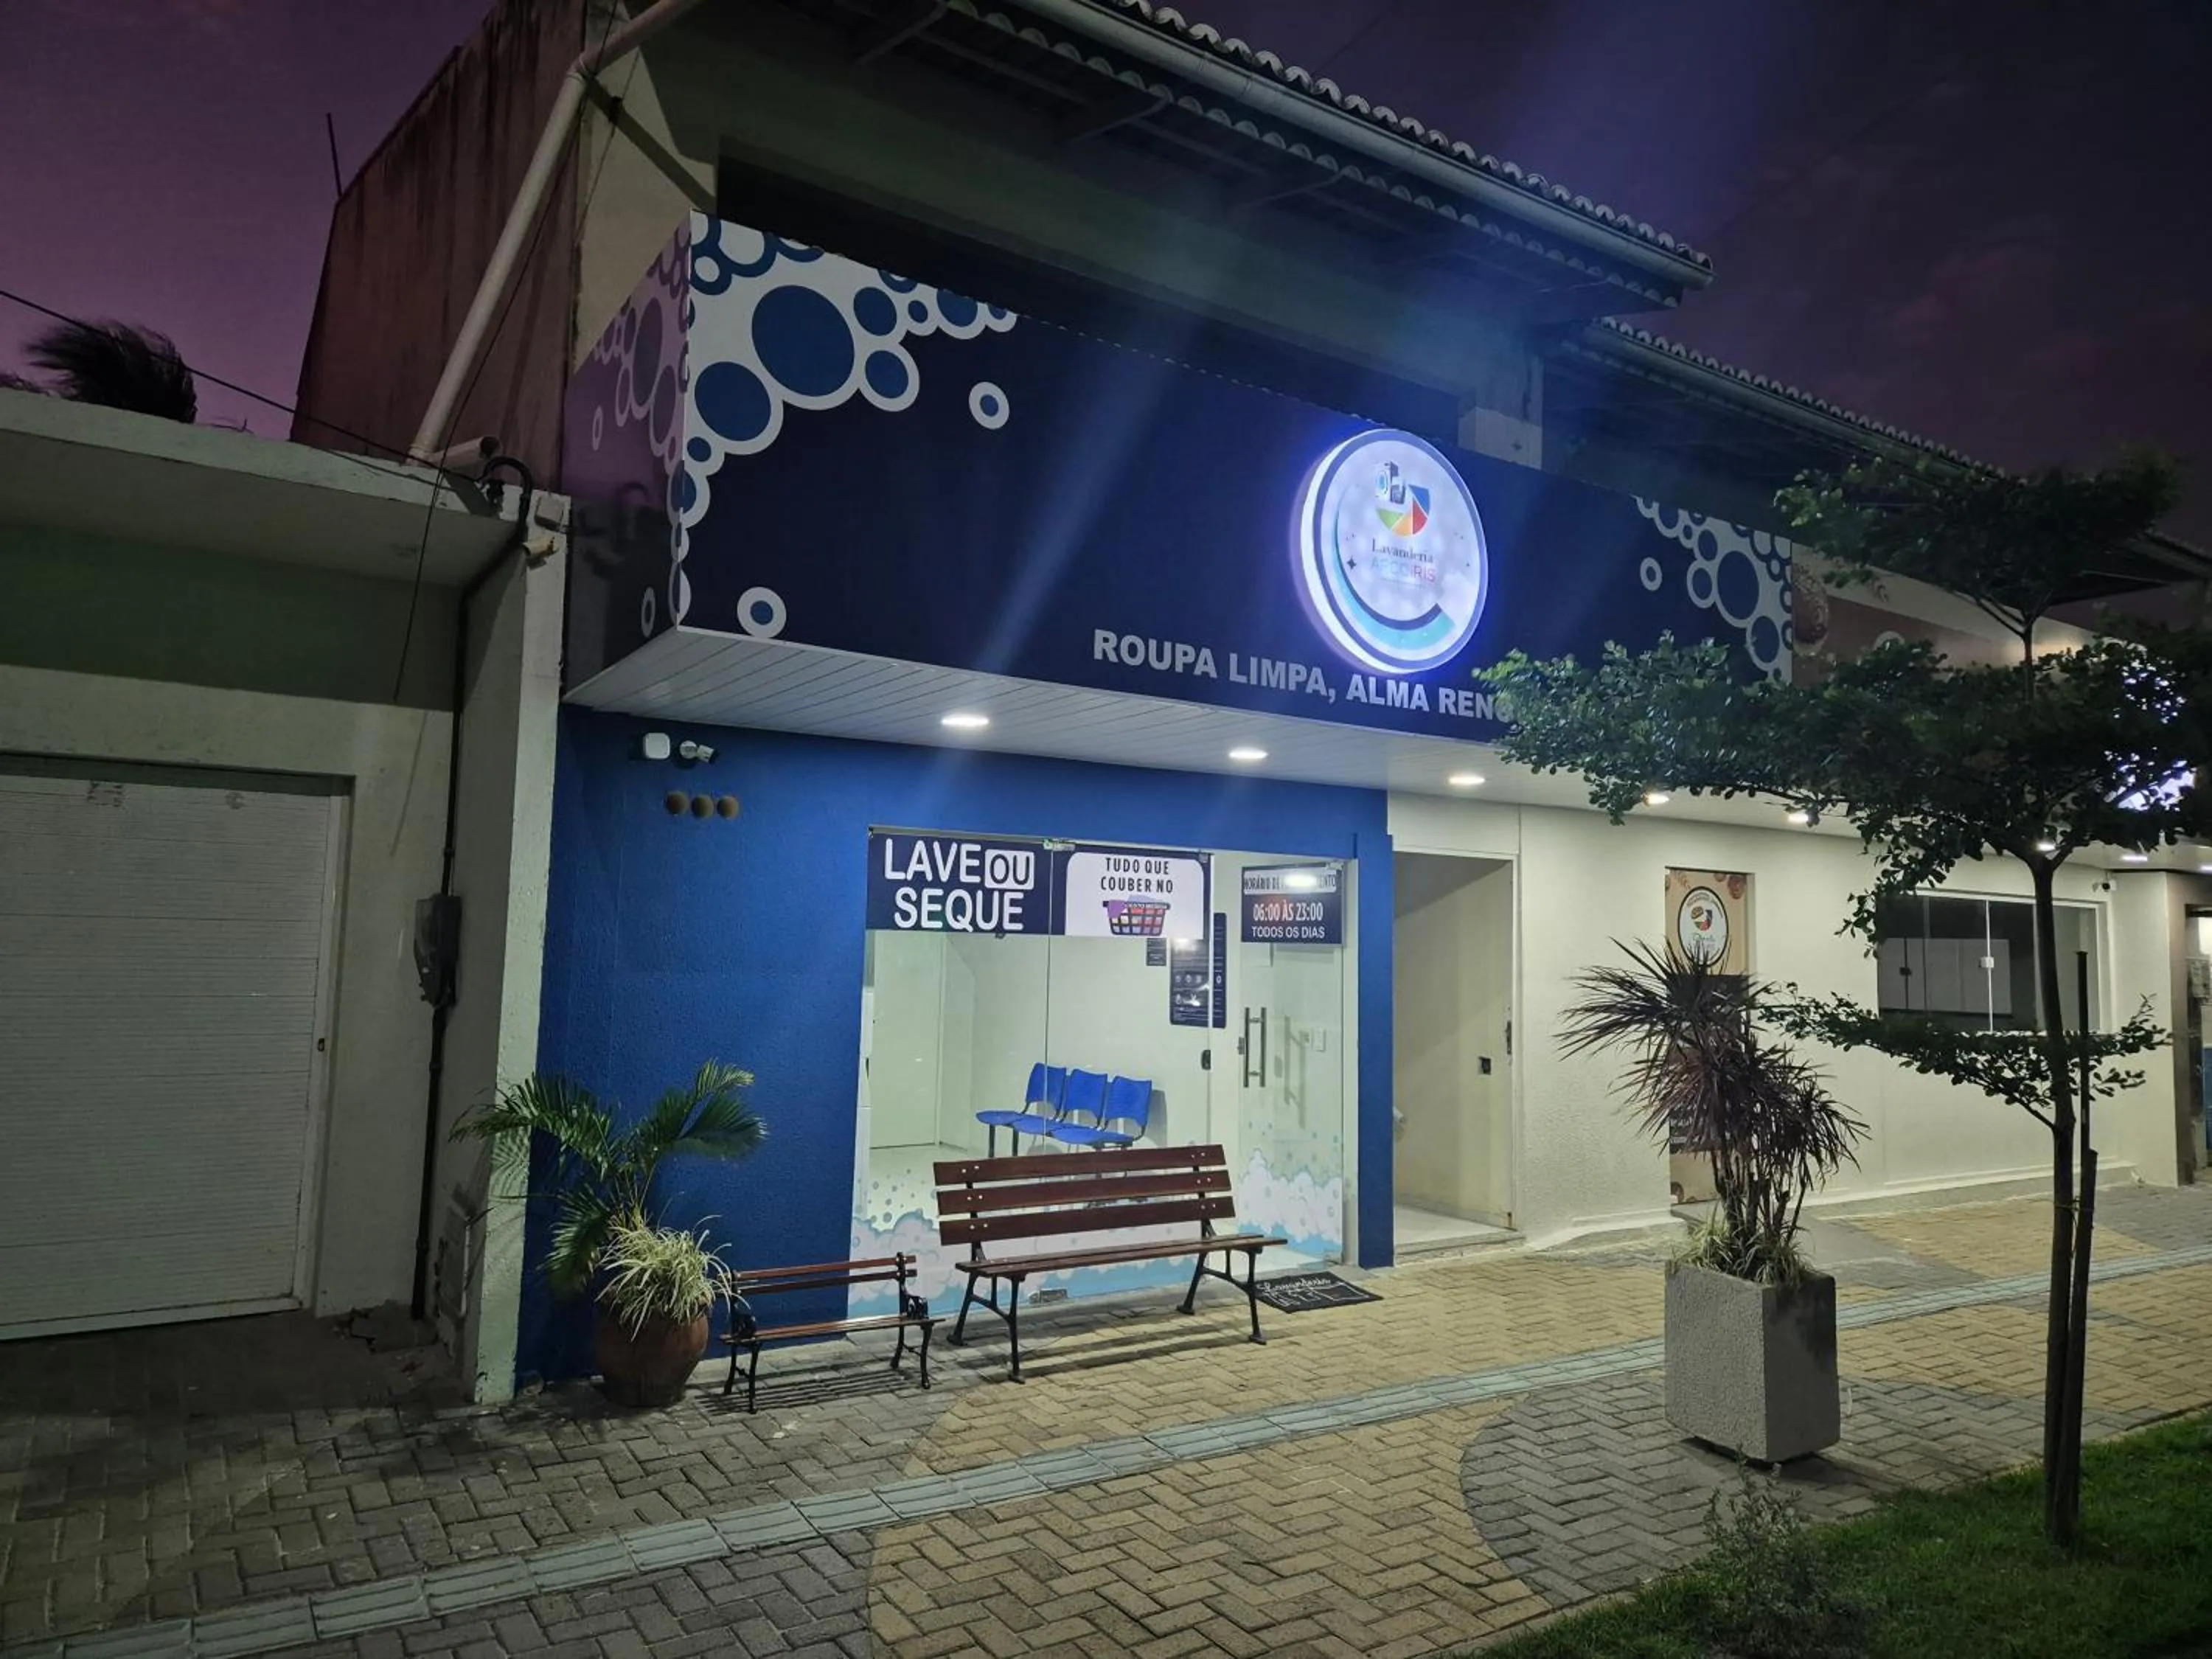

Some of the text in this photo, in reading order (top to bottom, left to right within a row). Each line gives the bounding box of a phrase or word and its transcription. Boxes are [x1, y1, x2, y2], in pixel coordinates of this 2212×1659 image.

[1372, 537, 1434, 563] Lavanderia
[1093, 629, 1217, 678] ROUPA
[1228, 653, 1336, 703] LIMPA,
[1346, 674, 1430, 712] ALMA
[885, 838, 1029, 886] LAVE OU
[1106, 858, 1169, 875] TUDO QUE
[1101, 876, 1173, 894] COUBER NO
[894, 887, 1024, 933] SEQUE
[1253, 899, 1324, 921] 06:00 ÀS 23:00
[1251, 926, 1325, 938] TODOS OS DIAS
